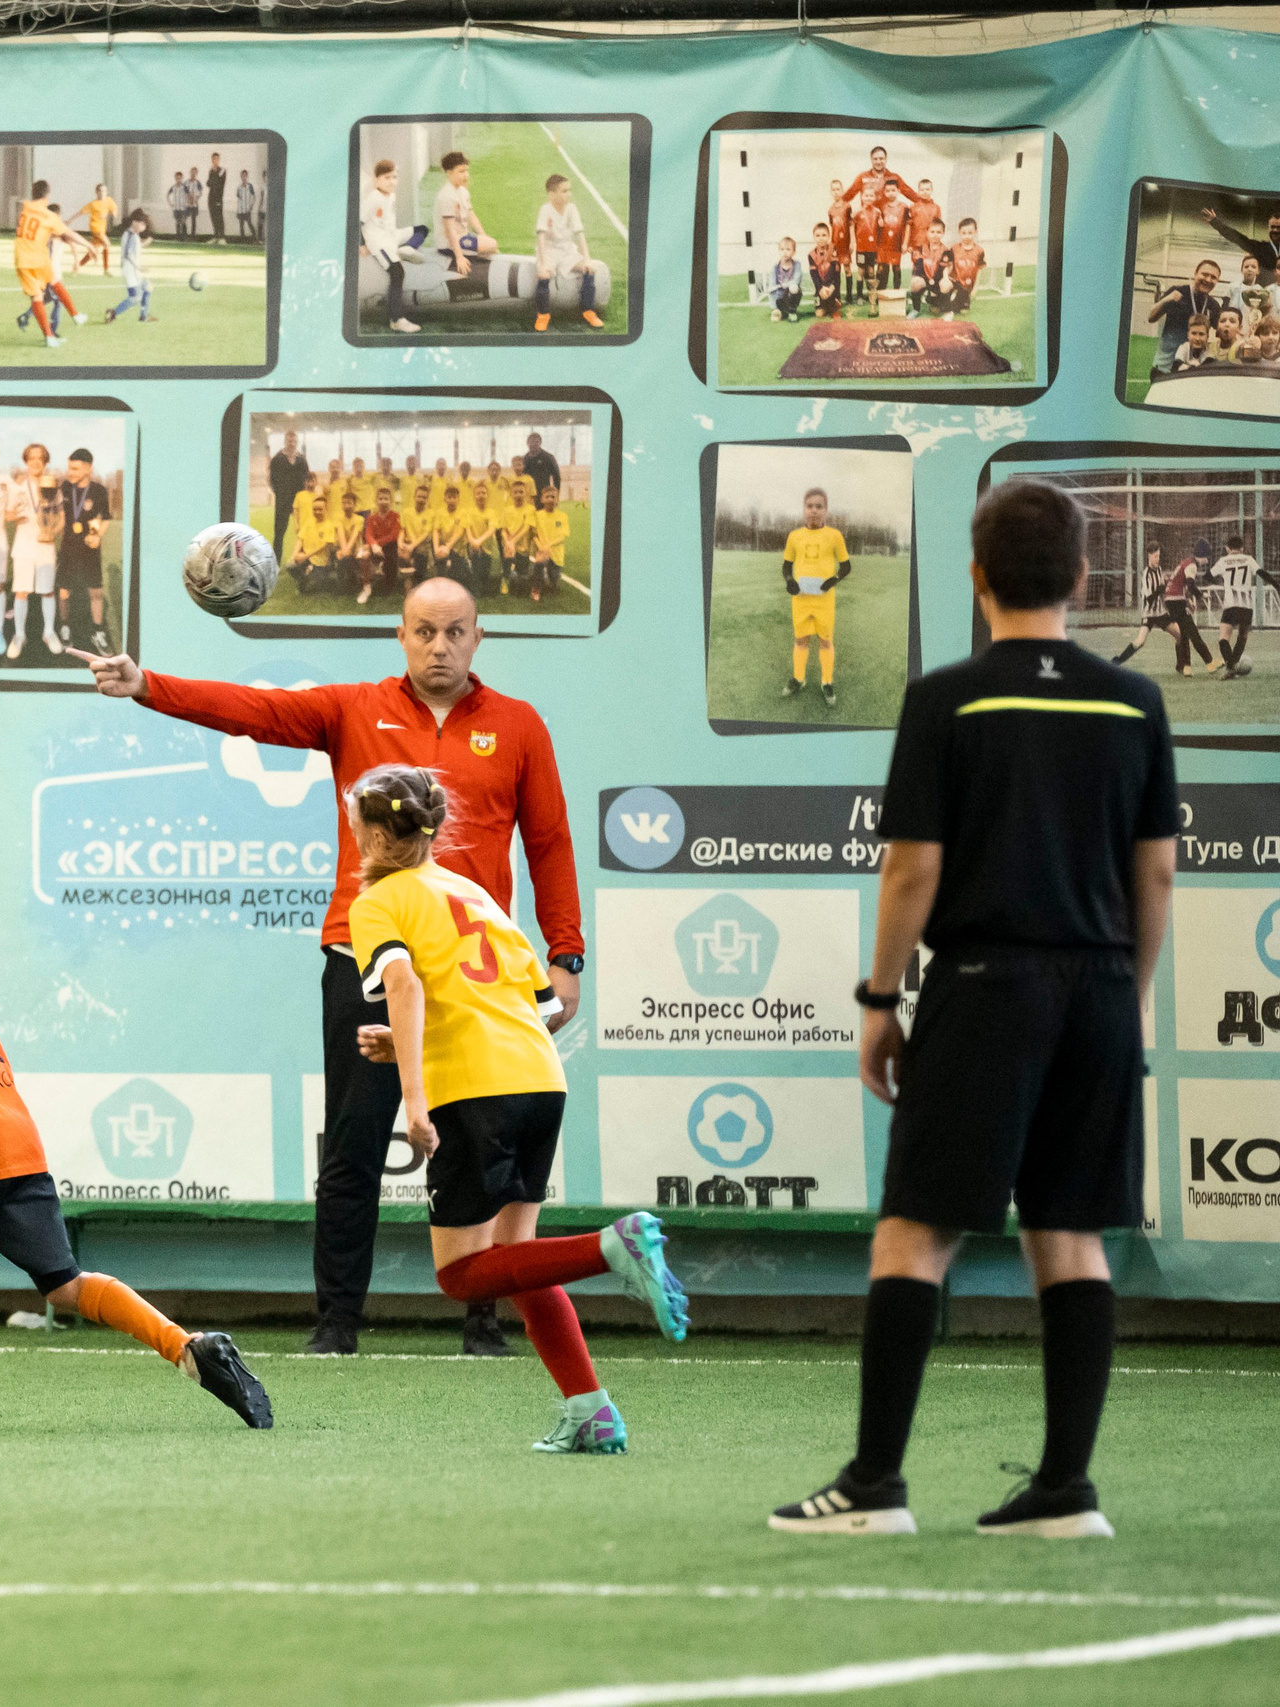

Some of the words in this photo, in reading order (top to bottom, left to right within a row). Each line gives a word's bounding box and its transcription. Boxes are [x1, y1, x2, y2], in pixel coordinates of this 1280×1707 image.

[1225, 565, 1248, 587] 77
[690, 836, 832, 867] @Детские
[1182, 835, 1243, 865] Туле
[62, 888, 231, 905] межсезонная
[252, 910, 316, 927] лига
[446, 894, 499, 984] 5
[642, 997, 744, 1023] Экспресс
[752, 998, 815, 1024] Офис
[604, 1025, 664, 1041] мебель
[670, 1027, 700, 1043] для
[705, 1025, 786, 1044] успешной
[792, 1026, 854, 1045] работы
[59, 1179, 161, 1200] Экспресс
[169, 1180, 230, 1200] Офис
[1188, 1186, 1262, 1209] Производство
